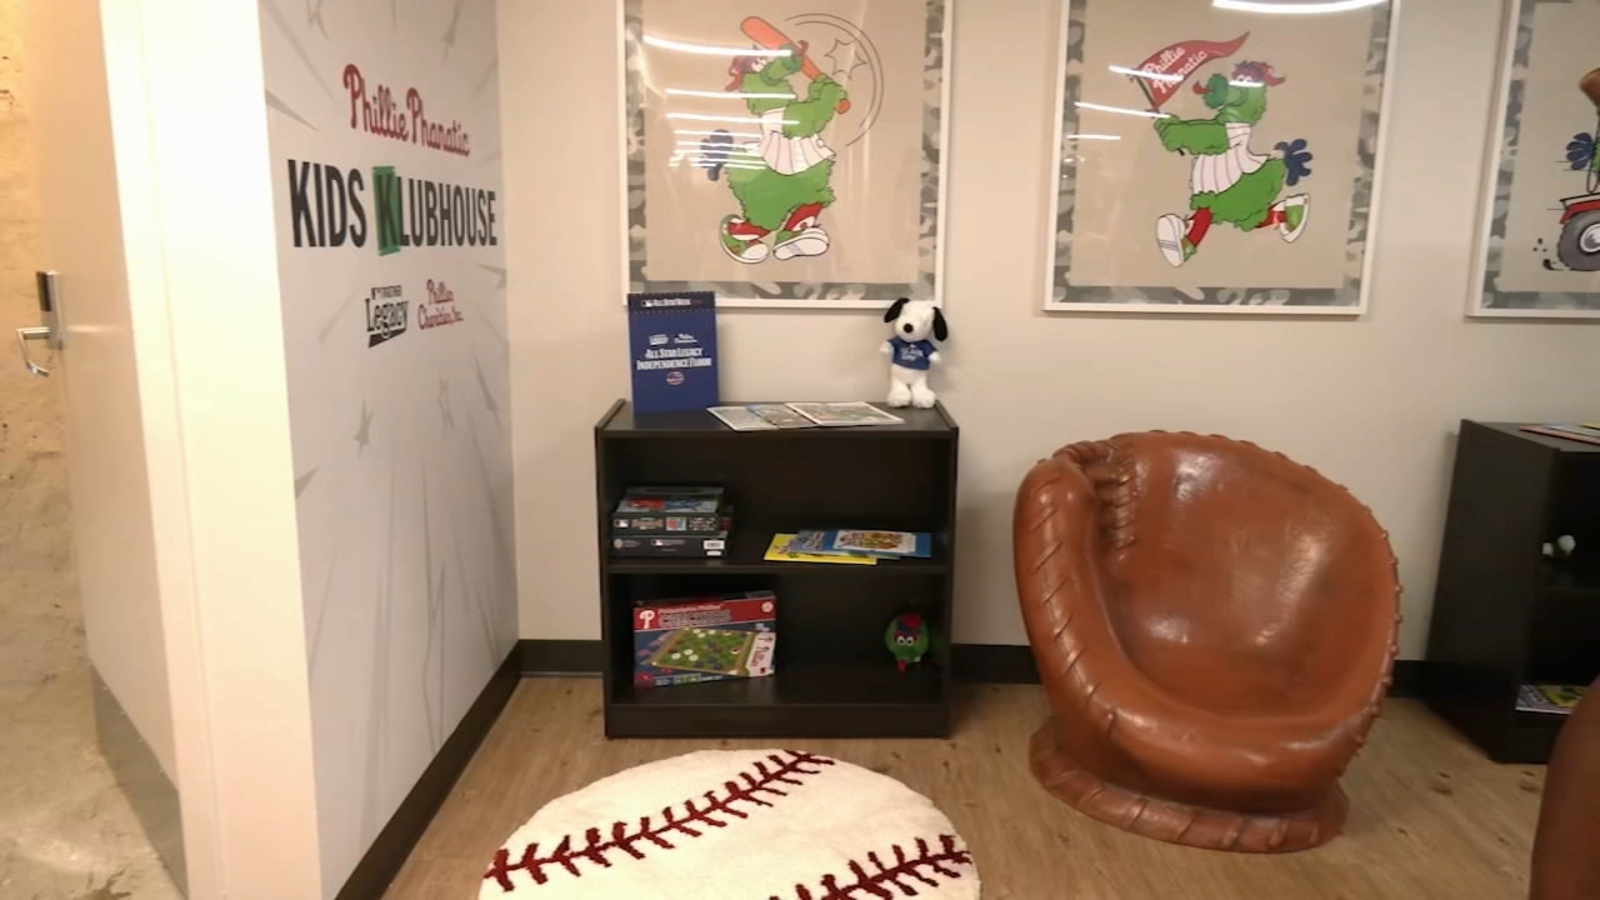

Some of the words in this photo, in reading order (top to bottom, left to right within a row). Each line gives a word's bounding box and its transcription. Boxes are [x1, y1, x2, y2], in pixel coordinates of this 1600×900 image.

[343, 63, 409, 141] Phillie
[406, 87, 470, 157] Phanatic
[287, 158, 367, 248] KIDS
[374, 173, 497, 247] KLUBHOUSE
[365, 298, 408, 339] Legacy
